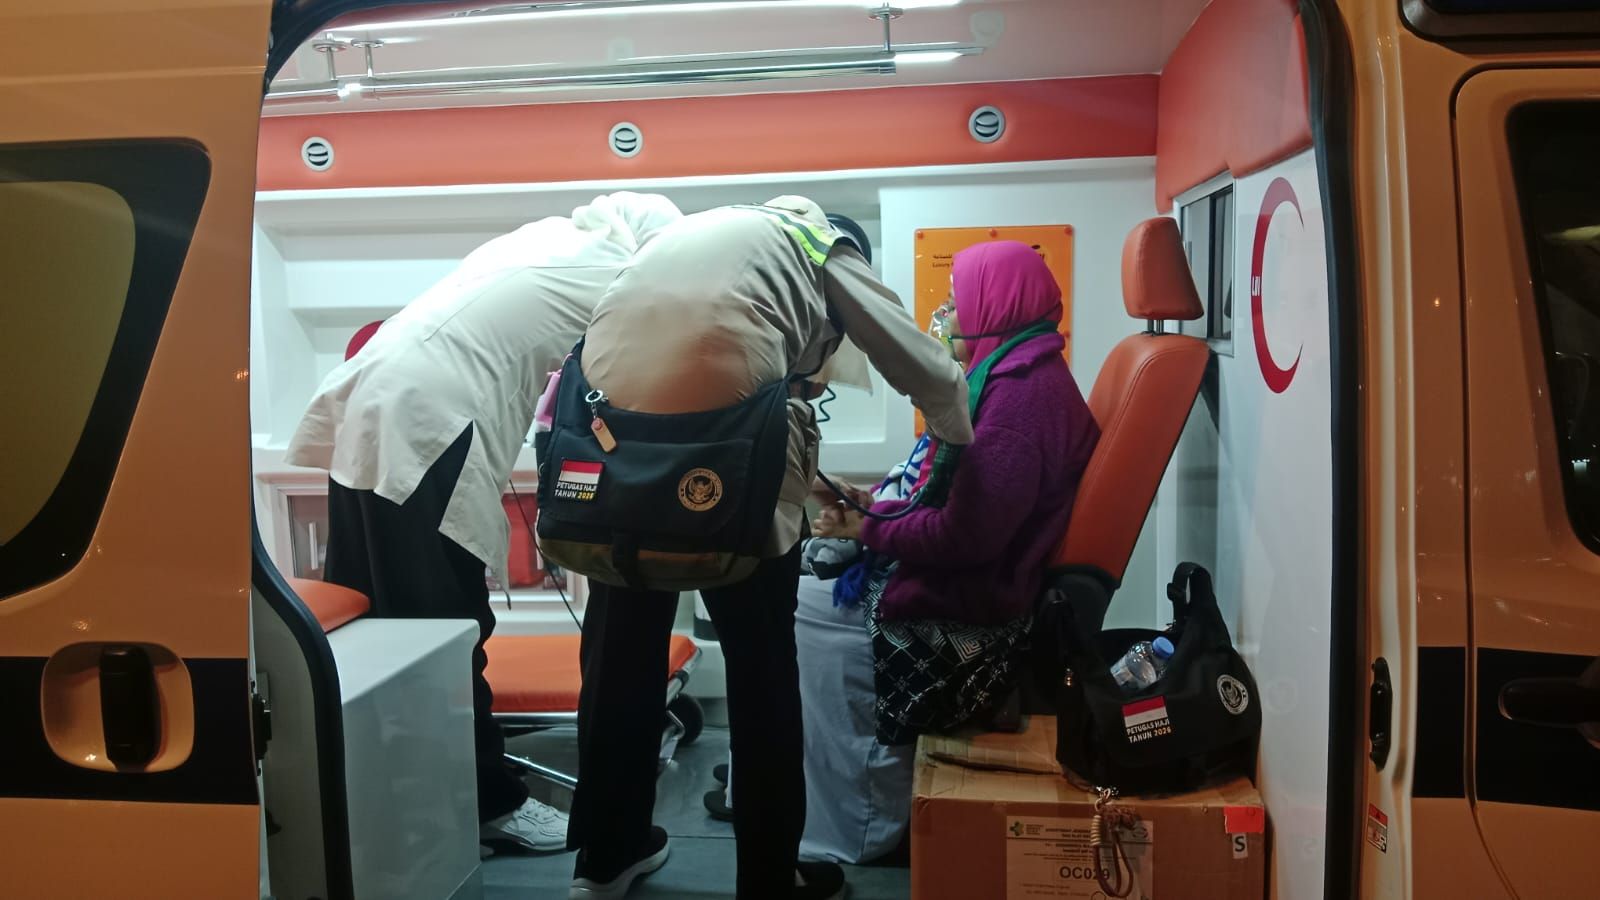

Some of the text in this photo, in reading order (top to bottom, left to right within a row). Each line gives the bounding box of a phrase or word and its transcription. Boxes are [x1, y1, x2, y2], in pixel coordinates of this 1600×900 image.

[554, 489, 594, 500] TAHUN 2026
[556, 481, 598, 492] PETUGAS HAJI
[1126, 718, 1170, 736] PETUGAS HAJI
[1128, 726, 1172, 743] TAHUN 2026
[1234, 835, 1246, 852] S
